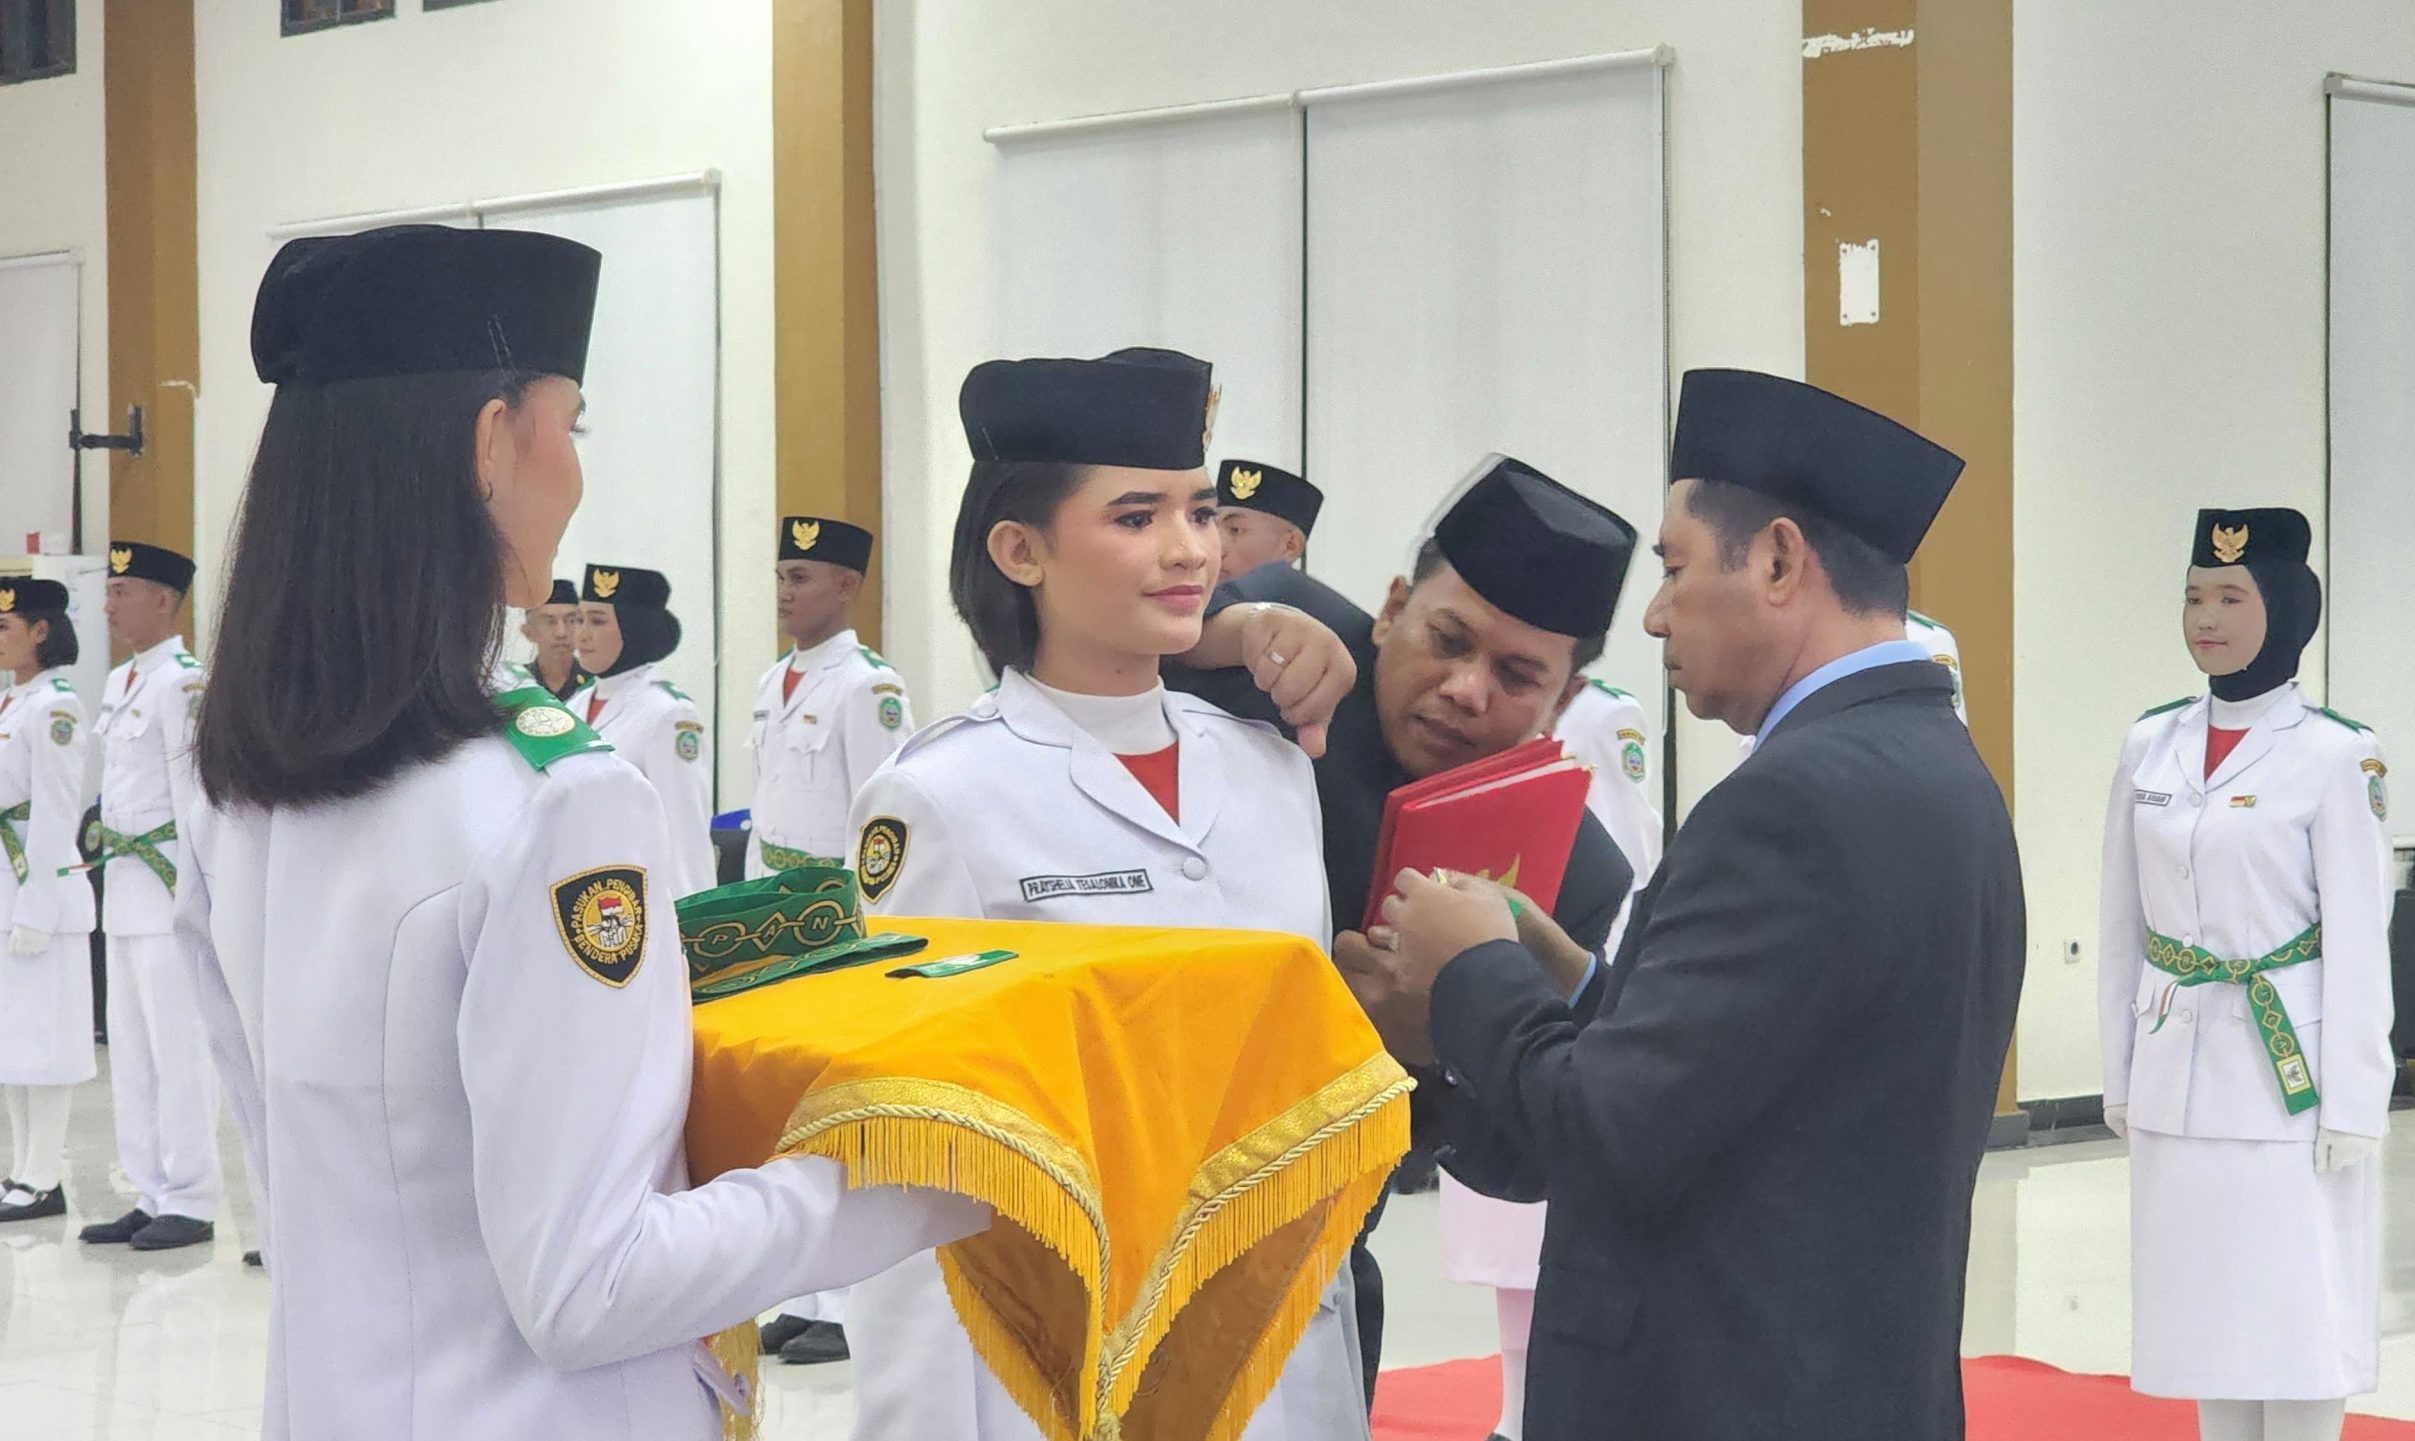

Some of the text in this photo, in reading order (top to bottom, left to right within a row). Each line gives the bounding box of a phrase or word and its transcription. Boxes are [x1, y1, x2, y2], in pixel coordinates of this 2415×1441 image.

[571, 878, 643, 929] PASUKAN PENGIBAR
[574, 924, 644, 965] BENDERA PUSAKA
